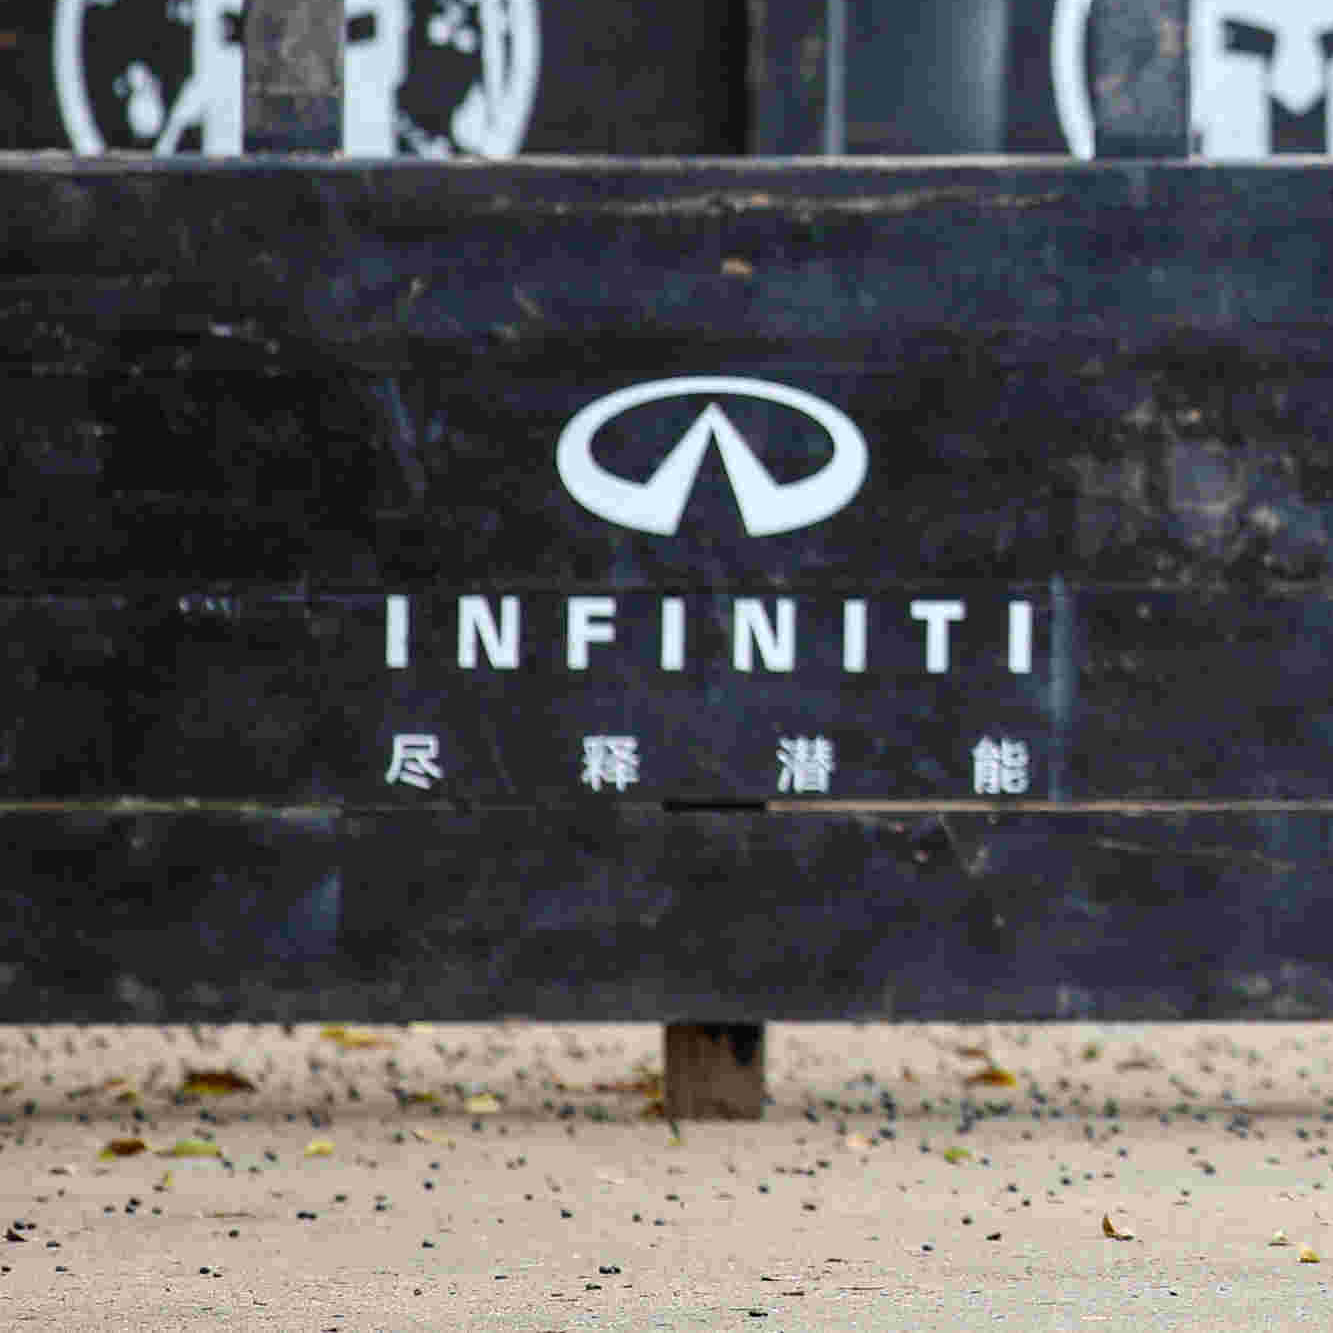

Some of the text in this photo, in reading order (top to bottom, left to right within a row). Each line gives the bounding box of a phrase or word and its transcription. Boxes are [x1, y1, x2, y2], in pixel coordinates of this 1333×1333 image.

[386, 595, 1033, 674] INFINITI
[385, 733, 1031, 795] 尽释潜能
